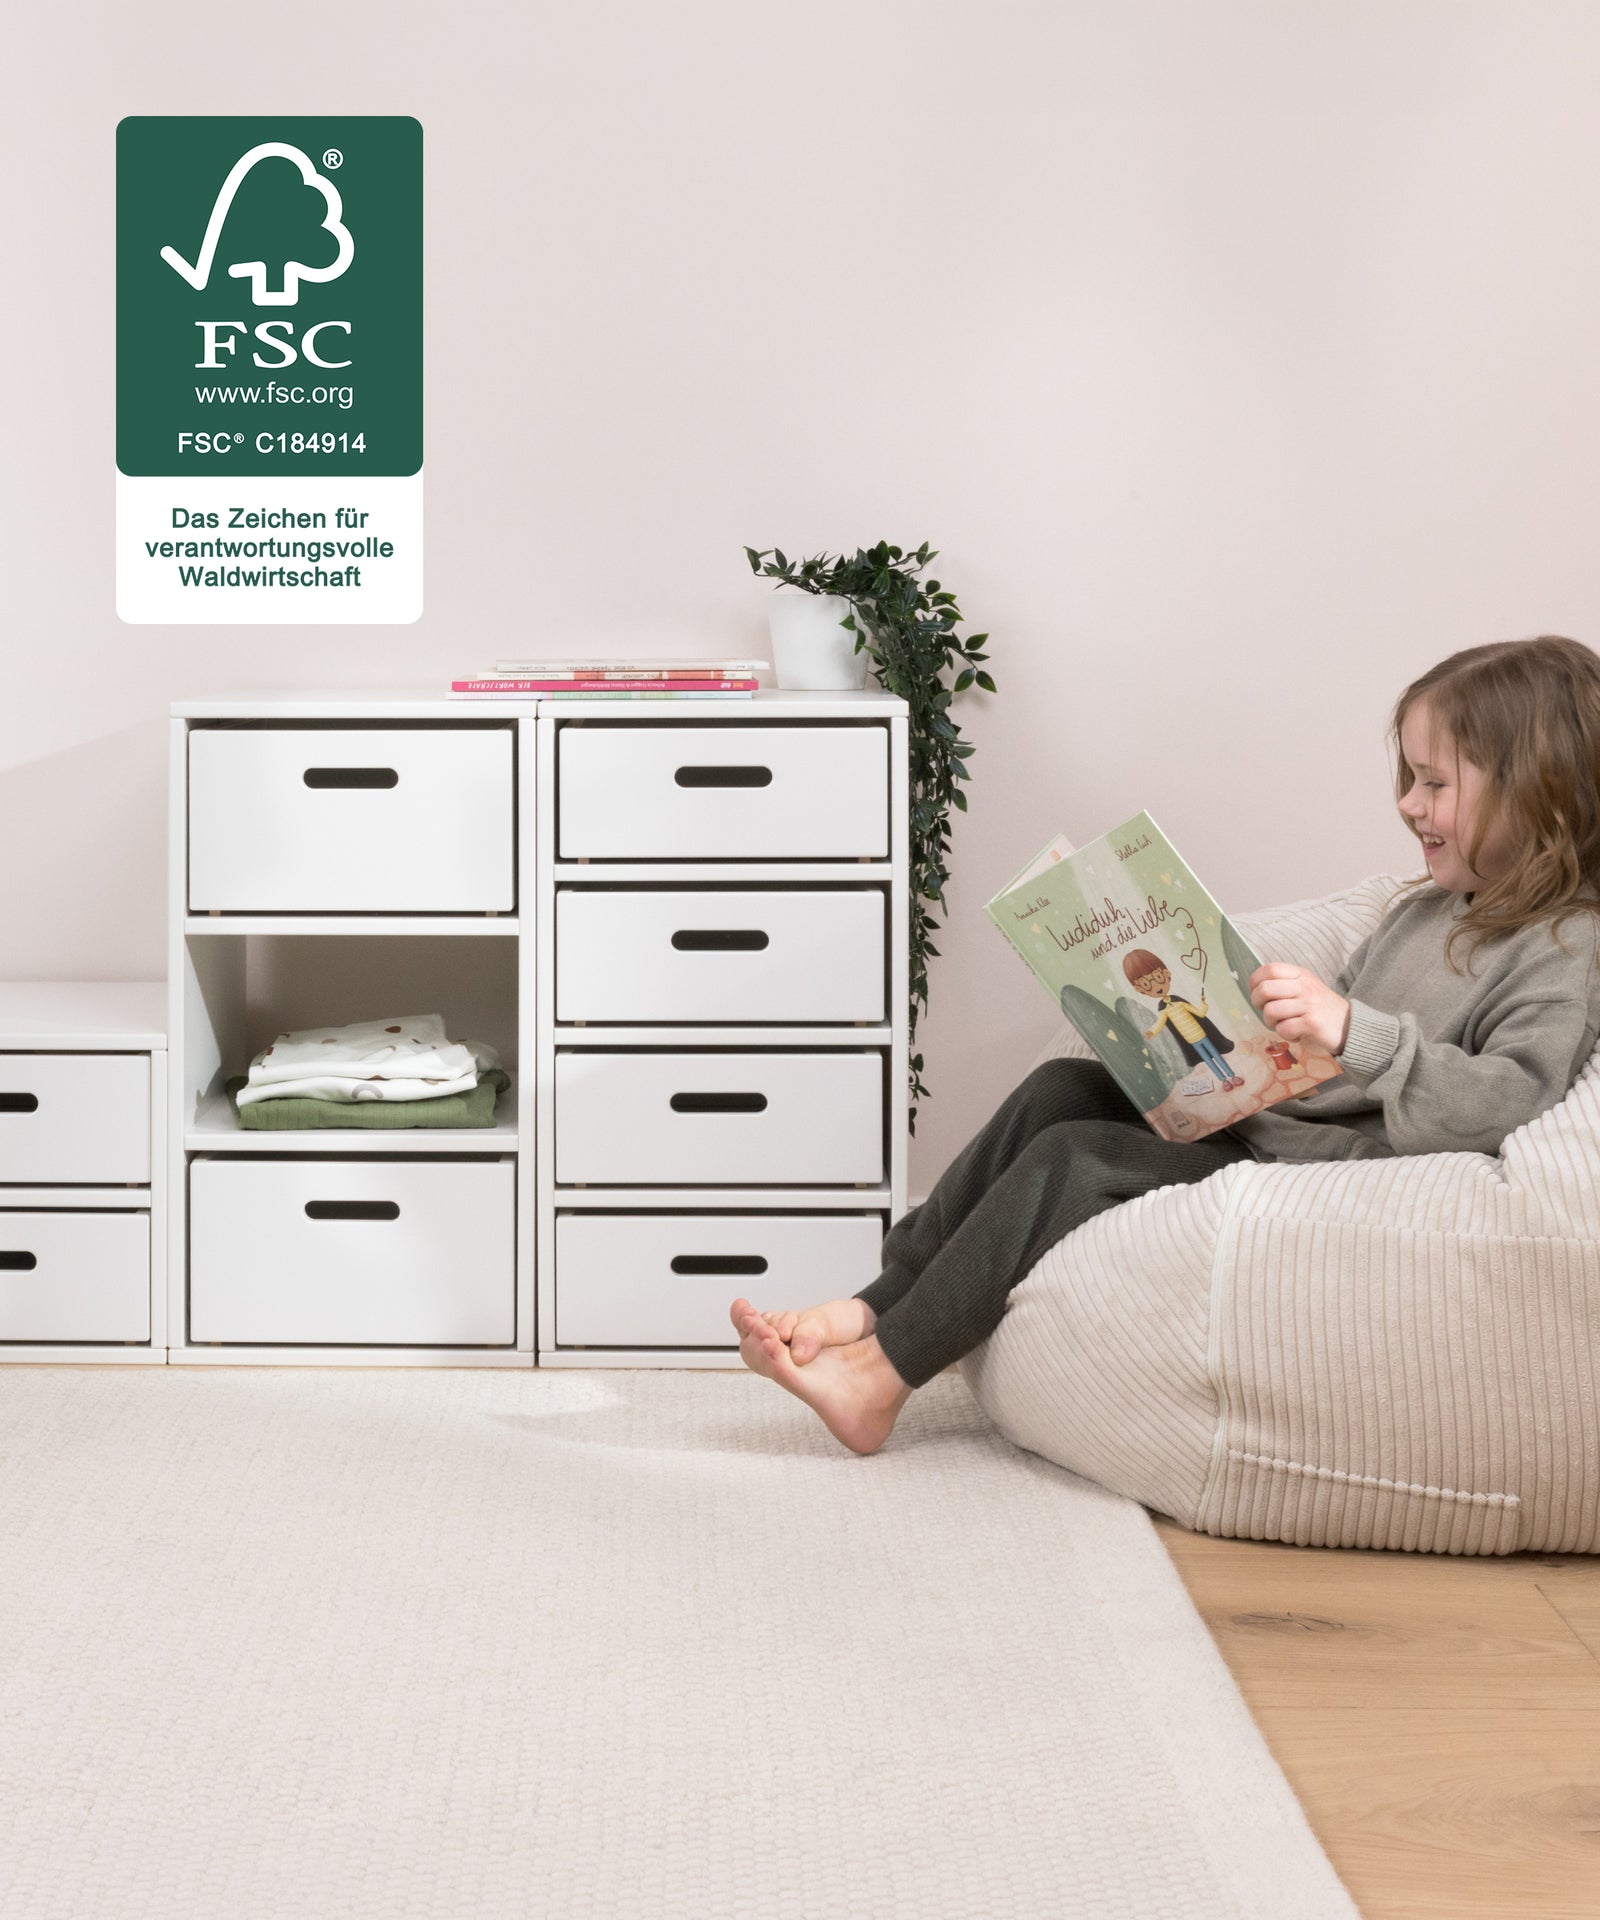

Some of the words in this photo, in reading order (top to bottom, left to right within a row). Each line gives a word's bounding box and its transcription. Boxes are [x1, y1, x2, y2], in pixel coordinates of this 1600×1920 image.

[1045, 897, 1126, 952] Ludiduh
[1125, 896, 1175, 934] Liebe
[1090, 933, 1117, 961] und
[1117, 924, 1137, 945] die
